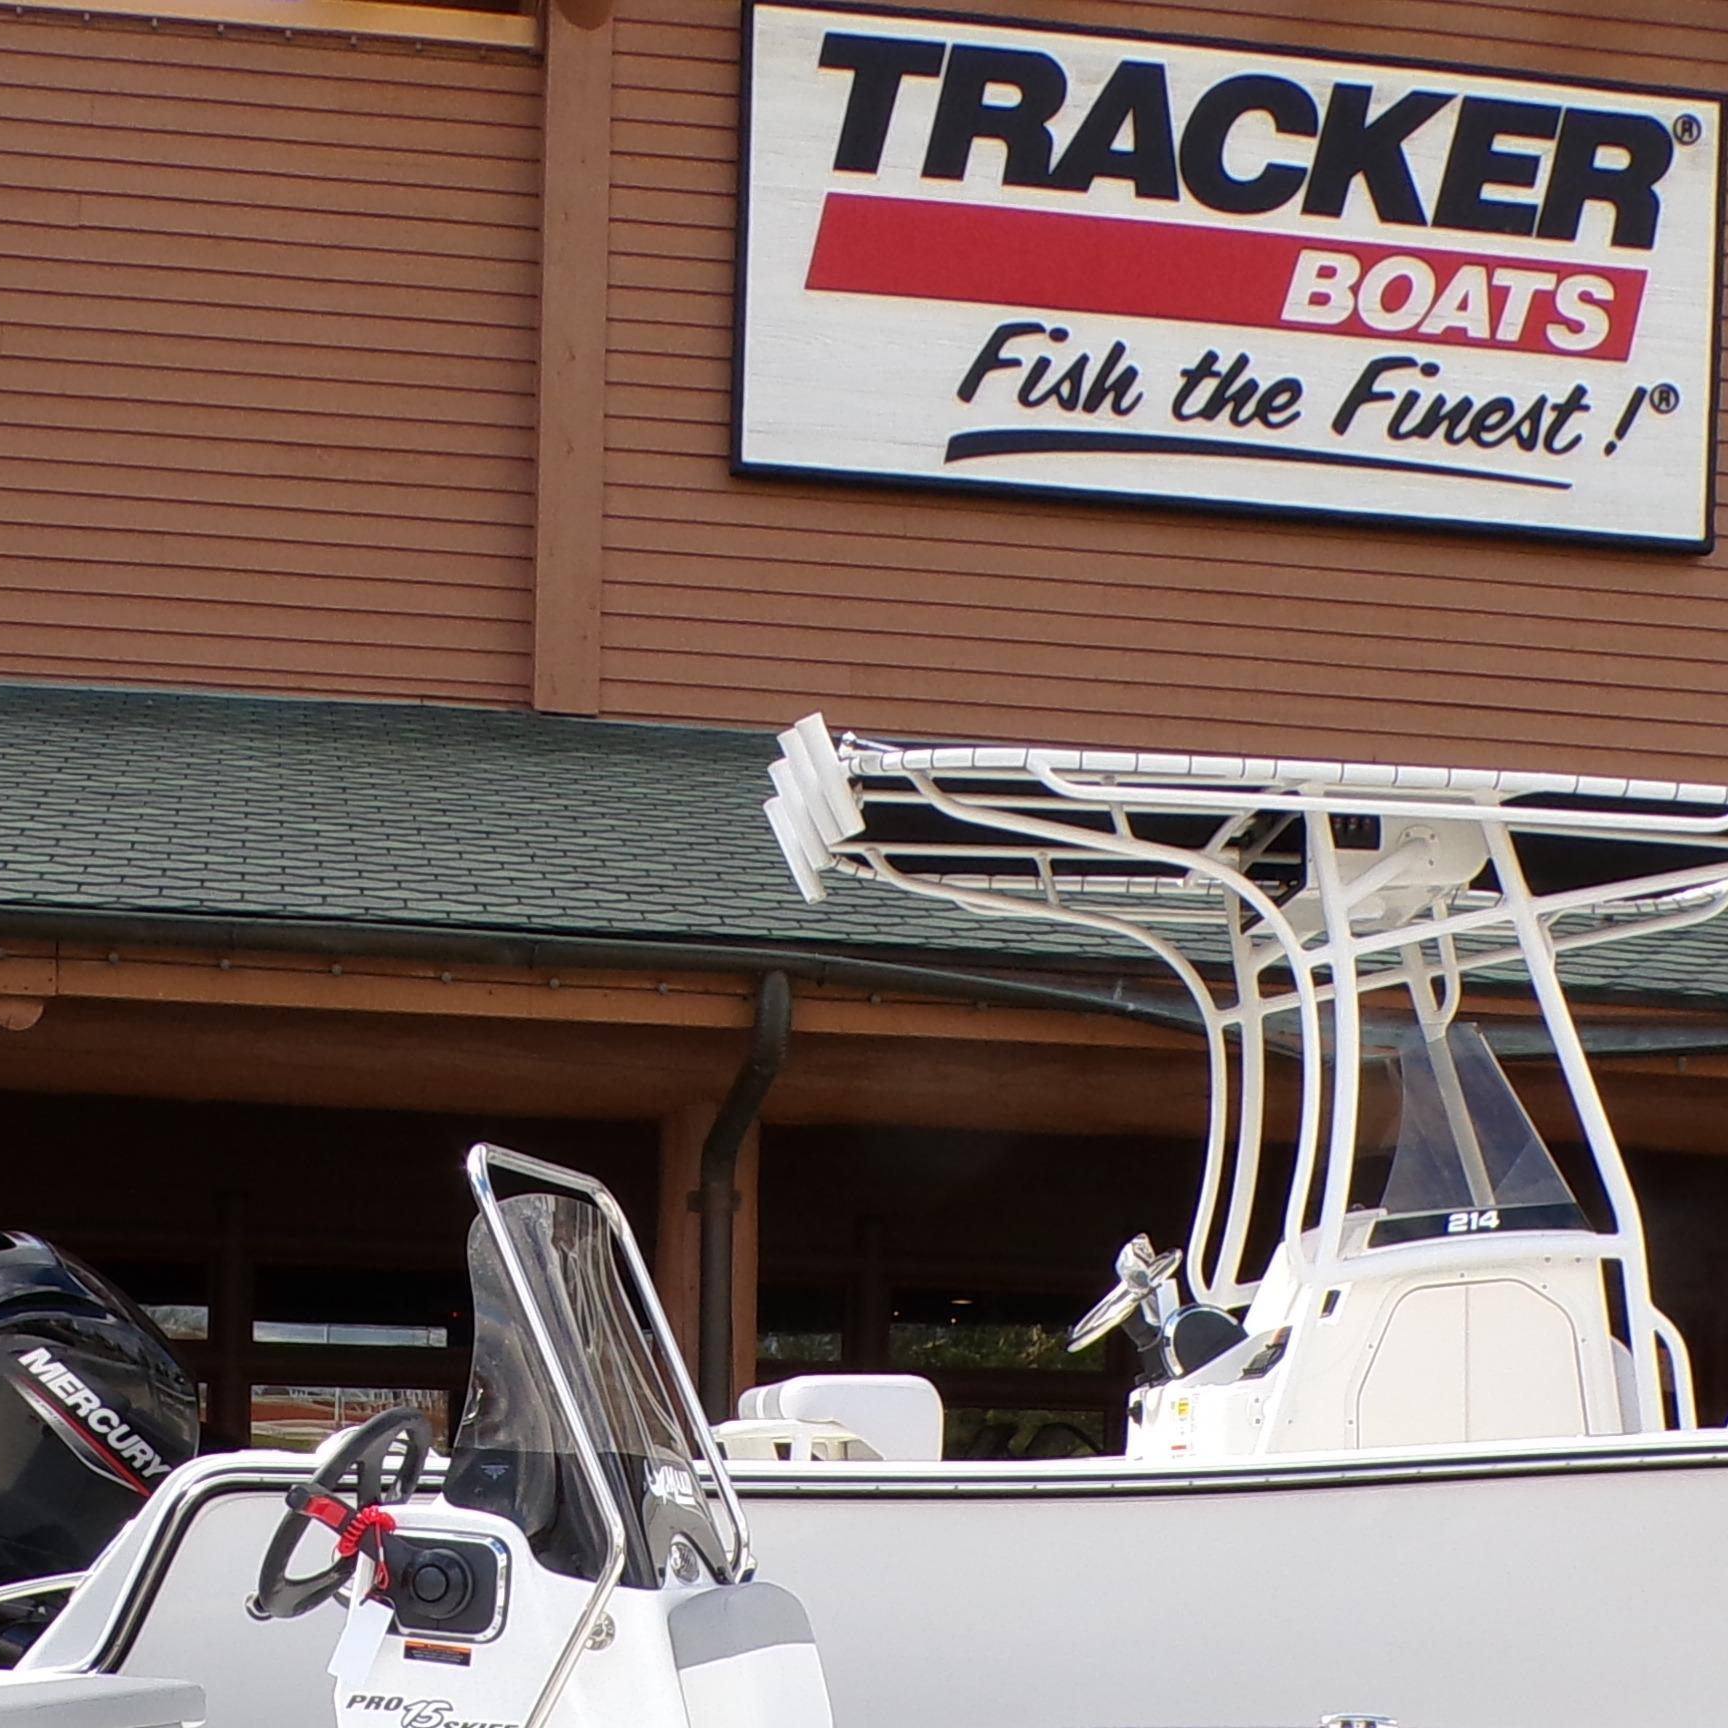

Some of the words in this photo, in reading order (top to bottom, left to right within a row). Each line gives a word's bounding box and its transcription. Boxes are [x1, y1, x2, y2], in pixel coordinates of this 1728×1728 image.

[1280, 249, 1614, 351] BOATS
[956, 321, 1143, 415] Fish
[1172, 349, 1303, 428] the
[1448, 1210, 1501, 1232] 214
[17, 1347, 172, 1478] MERCURY
[346, 1694, 404, 1712] PRO
